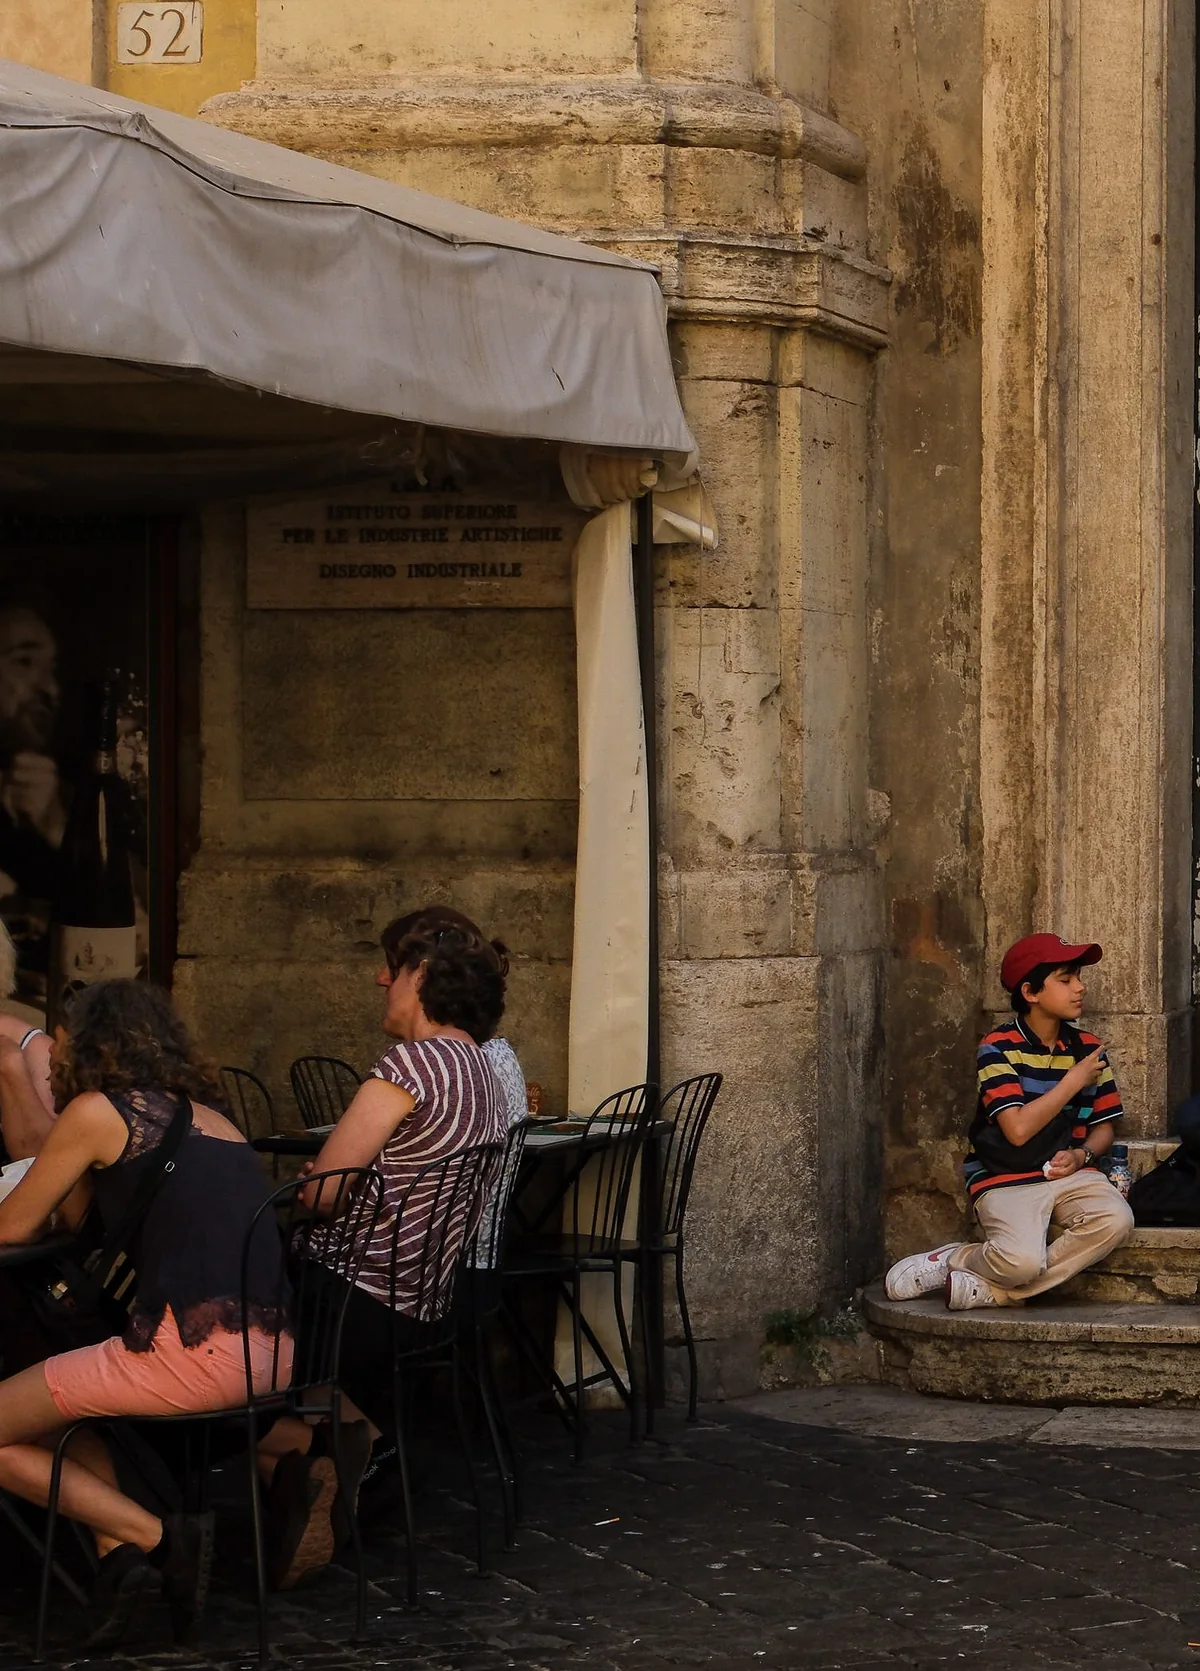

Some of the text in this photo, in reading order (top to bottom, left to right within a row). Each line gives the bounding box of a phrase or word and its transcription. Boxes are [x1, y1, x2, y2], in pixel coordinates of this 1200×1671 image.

[126, 9, 190, 56] 52
[327, 504, 518, 521] ISTITUTO SUPERIORE
[282, 526, 563, 544] PER LE INDUSTRIE ARTISTICHE
[319, 562, 522, 579] DISEGNO INDUSTRIALE
